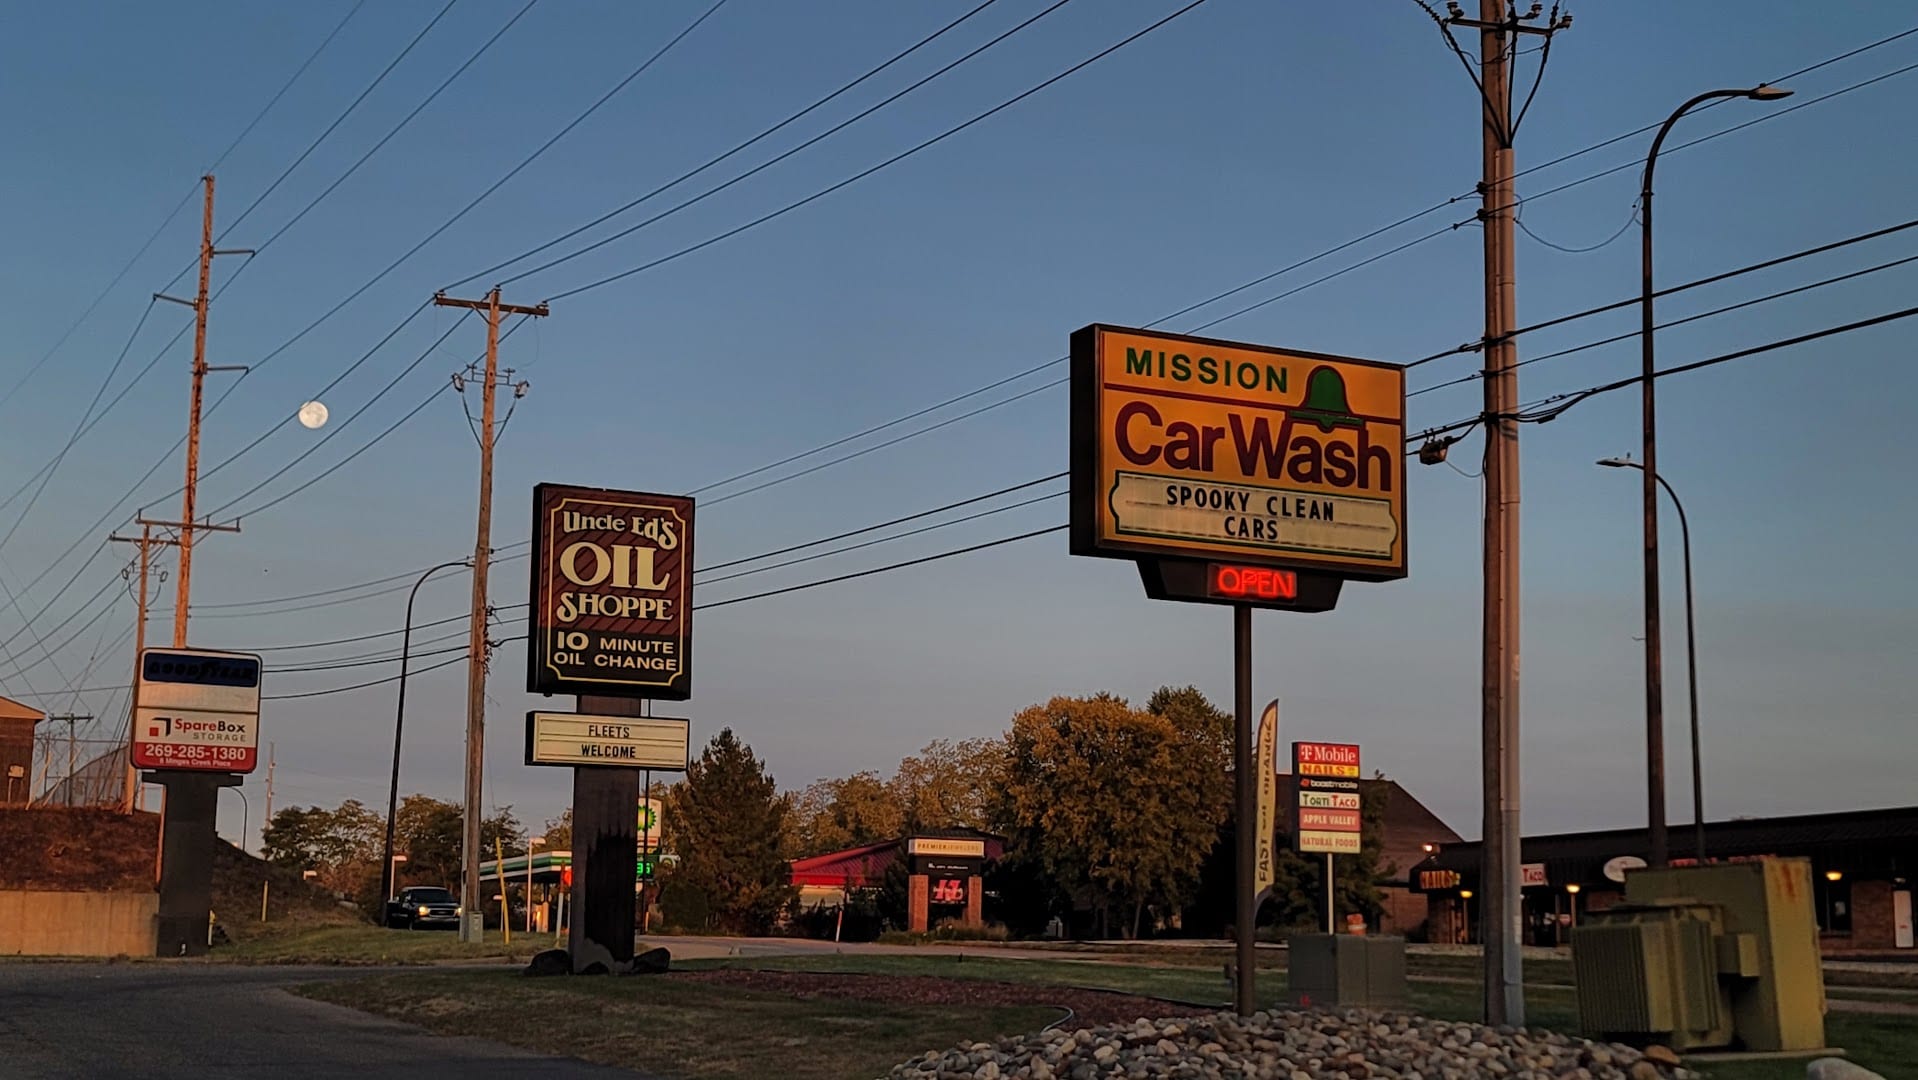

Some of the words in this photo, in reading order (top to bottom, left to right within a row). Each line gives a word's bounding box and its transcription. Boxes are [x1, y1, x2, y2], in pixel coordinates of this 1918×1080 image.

[1125, 346, 1288, 393] MISSION
[1114, 400, 1225, 473] Car
[1227, 412, 1392, 492] Wash
[1166, 484, 1250, 510] SPOOKY
[1266, 495, 1334, 522] CLEAN
[563, 511, 626, 534] Uncle
[1223, 515, 1279, 540] CARS
[559, 541, 671, 591] OIL
[1217, 565, 1296, 598] OPEN
[556, 591, 674, 623] SHOPPE
[556, 630, 590, 651] 10
[599, 637, 674, 655] MINUTE
[553, 651, 586, 666] OIL
[593, 653, 678, 672] CHANGE
[174, 718, 246, 734] SpareBox
[588, 724, 631, 739] FLEETS
[192, 733, 246, 742] STORAGE
[144, 743, 247, 761] 269-285-1380
[581, 743, 636, 759] WELCOME
[1313, 746, 1357, 763] Mobile
[1302, 764, 1345, 776] NAILS
[1302, 793, 1330, 806] TORTI
[1331, 795, 1357, 808] TACO
[1303, 814, 1328, 825] APPLE
[1329, 815, 1357, 826] VALLEY
[1301, 836, 1334, 847] NATURAL
[1335, 838, 1358, 848] FOODS
[1258, 837, 1270, 882] FAST
